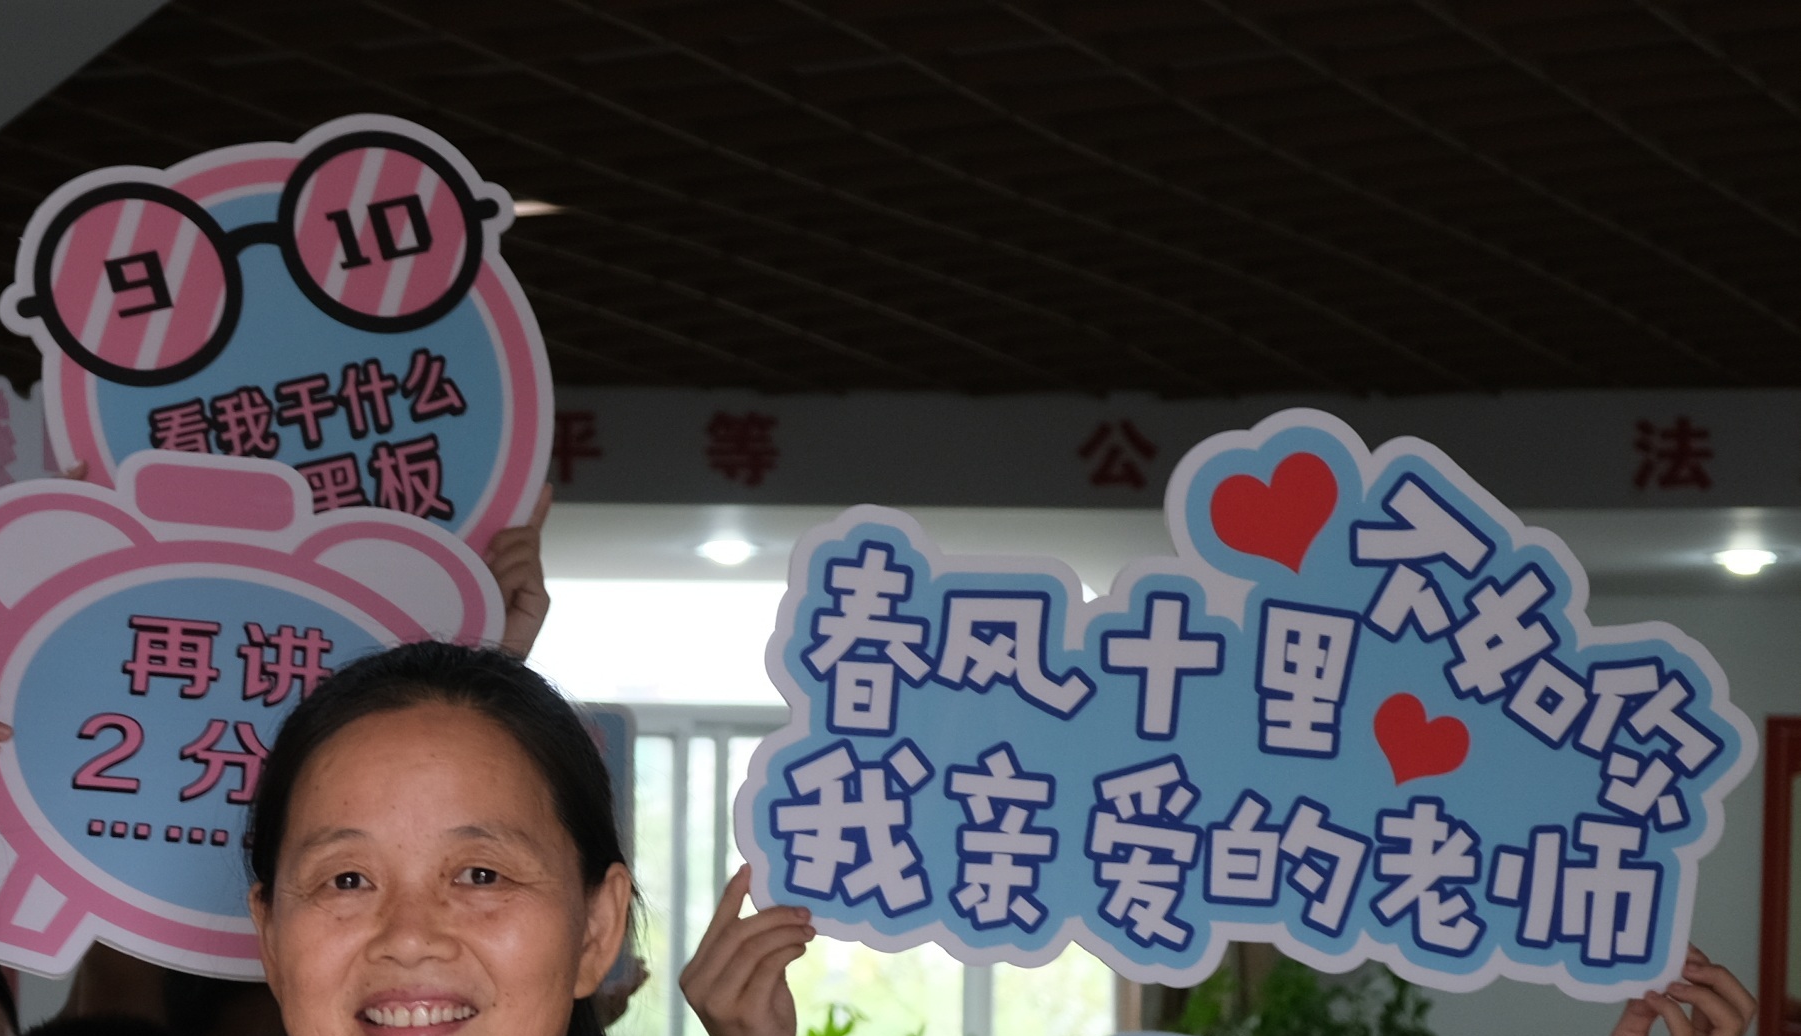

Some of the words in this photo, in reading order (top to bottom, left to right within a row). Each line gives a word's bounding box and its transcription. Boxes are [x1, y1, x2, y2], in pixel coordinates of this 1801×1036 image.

[103, 250, 174, 319] 9
[326, 193, 433, 270] 10
[150, 348, 466, 458] 看我干什么
[122, 614, 333, 707] 再讲
[807, 540, 1362, 759] 春风十里
[1349, 472, 1723, 830] 不如您
[771, 739, 1663, 966] 我亲爱的老师
